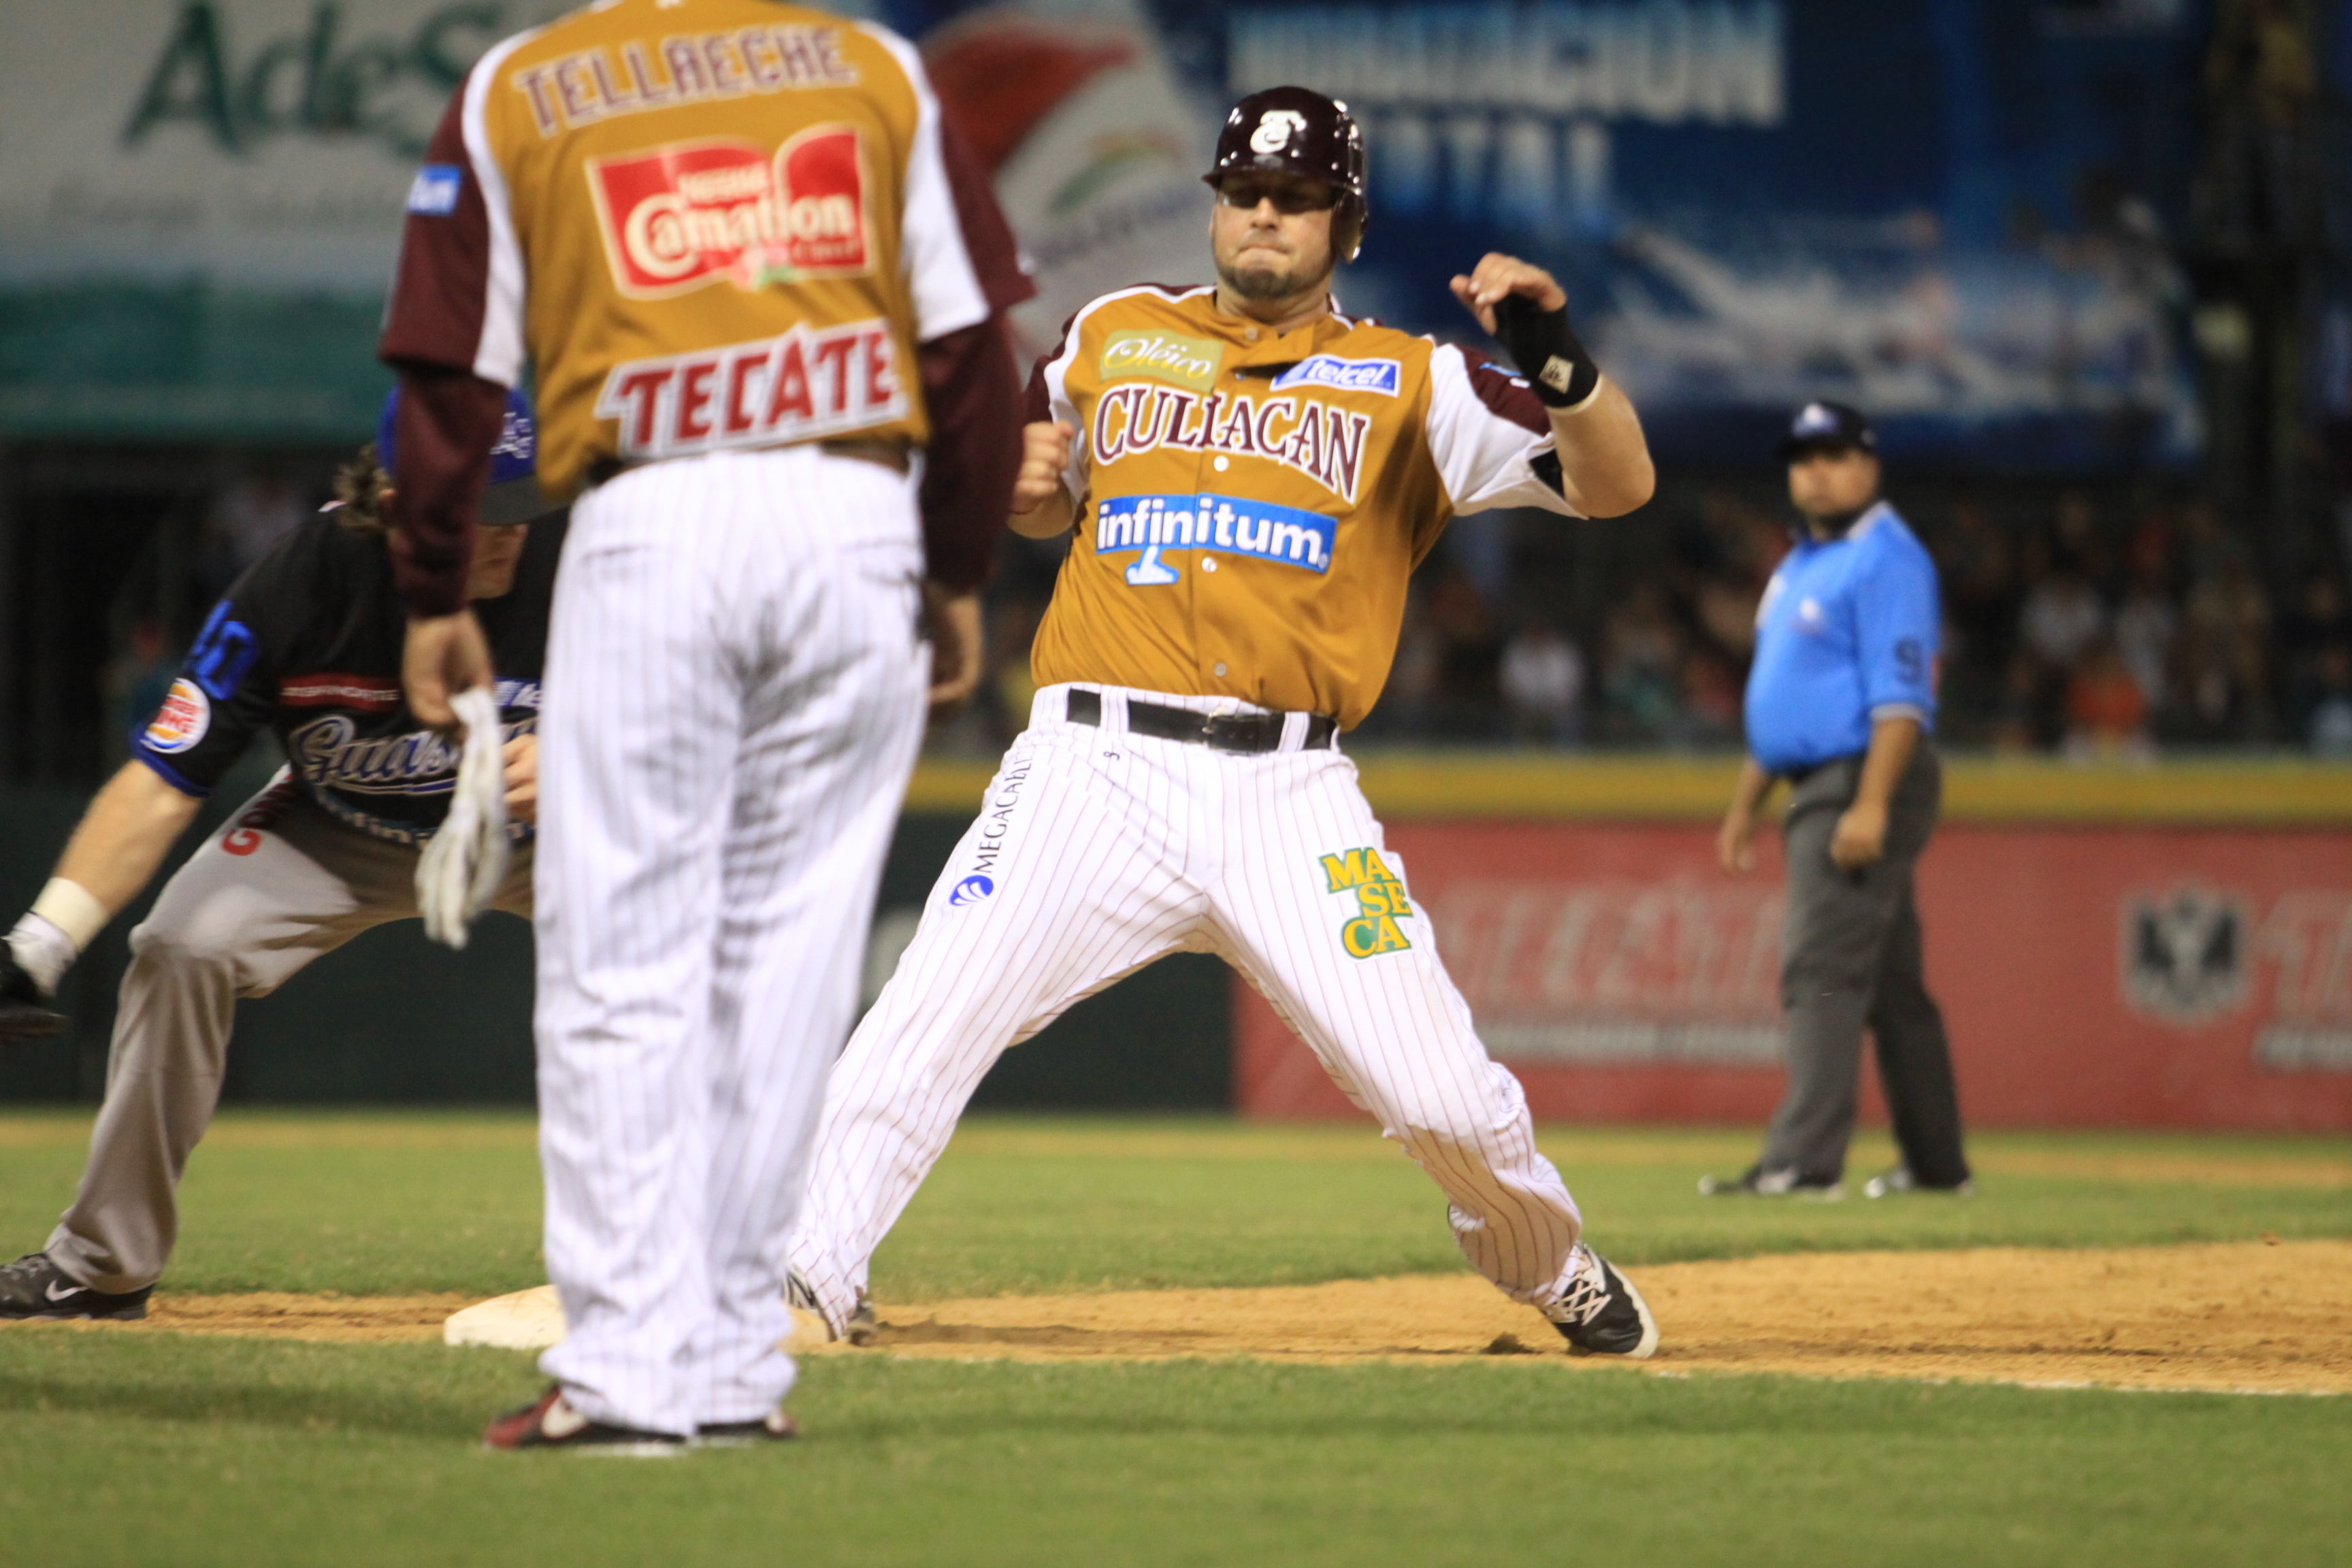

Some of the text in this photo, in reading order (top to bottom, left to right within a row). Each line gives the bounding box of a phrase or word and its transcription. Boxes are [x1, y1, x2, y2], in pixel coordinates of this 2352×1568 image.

[513, 24, 860, 138] TELLAECHE
[609, 324, 902, 449] TECATE
[1103, 337, 1213, 380] Oléico
[1093, 383, 1371, 505] CULIACAN
[1096, 497, 1323, 566] infinitum
